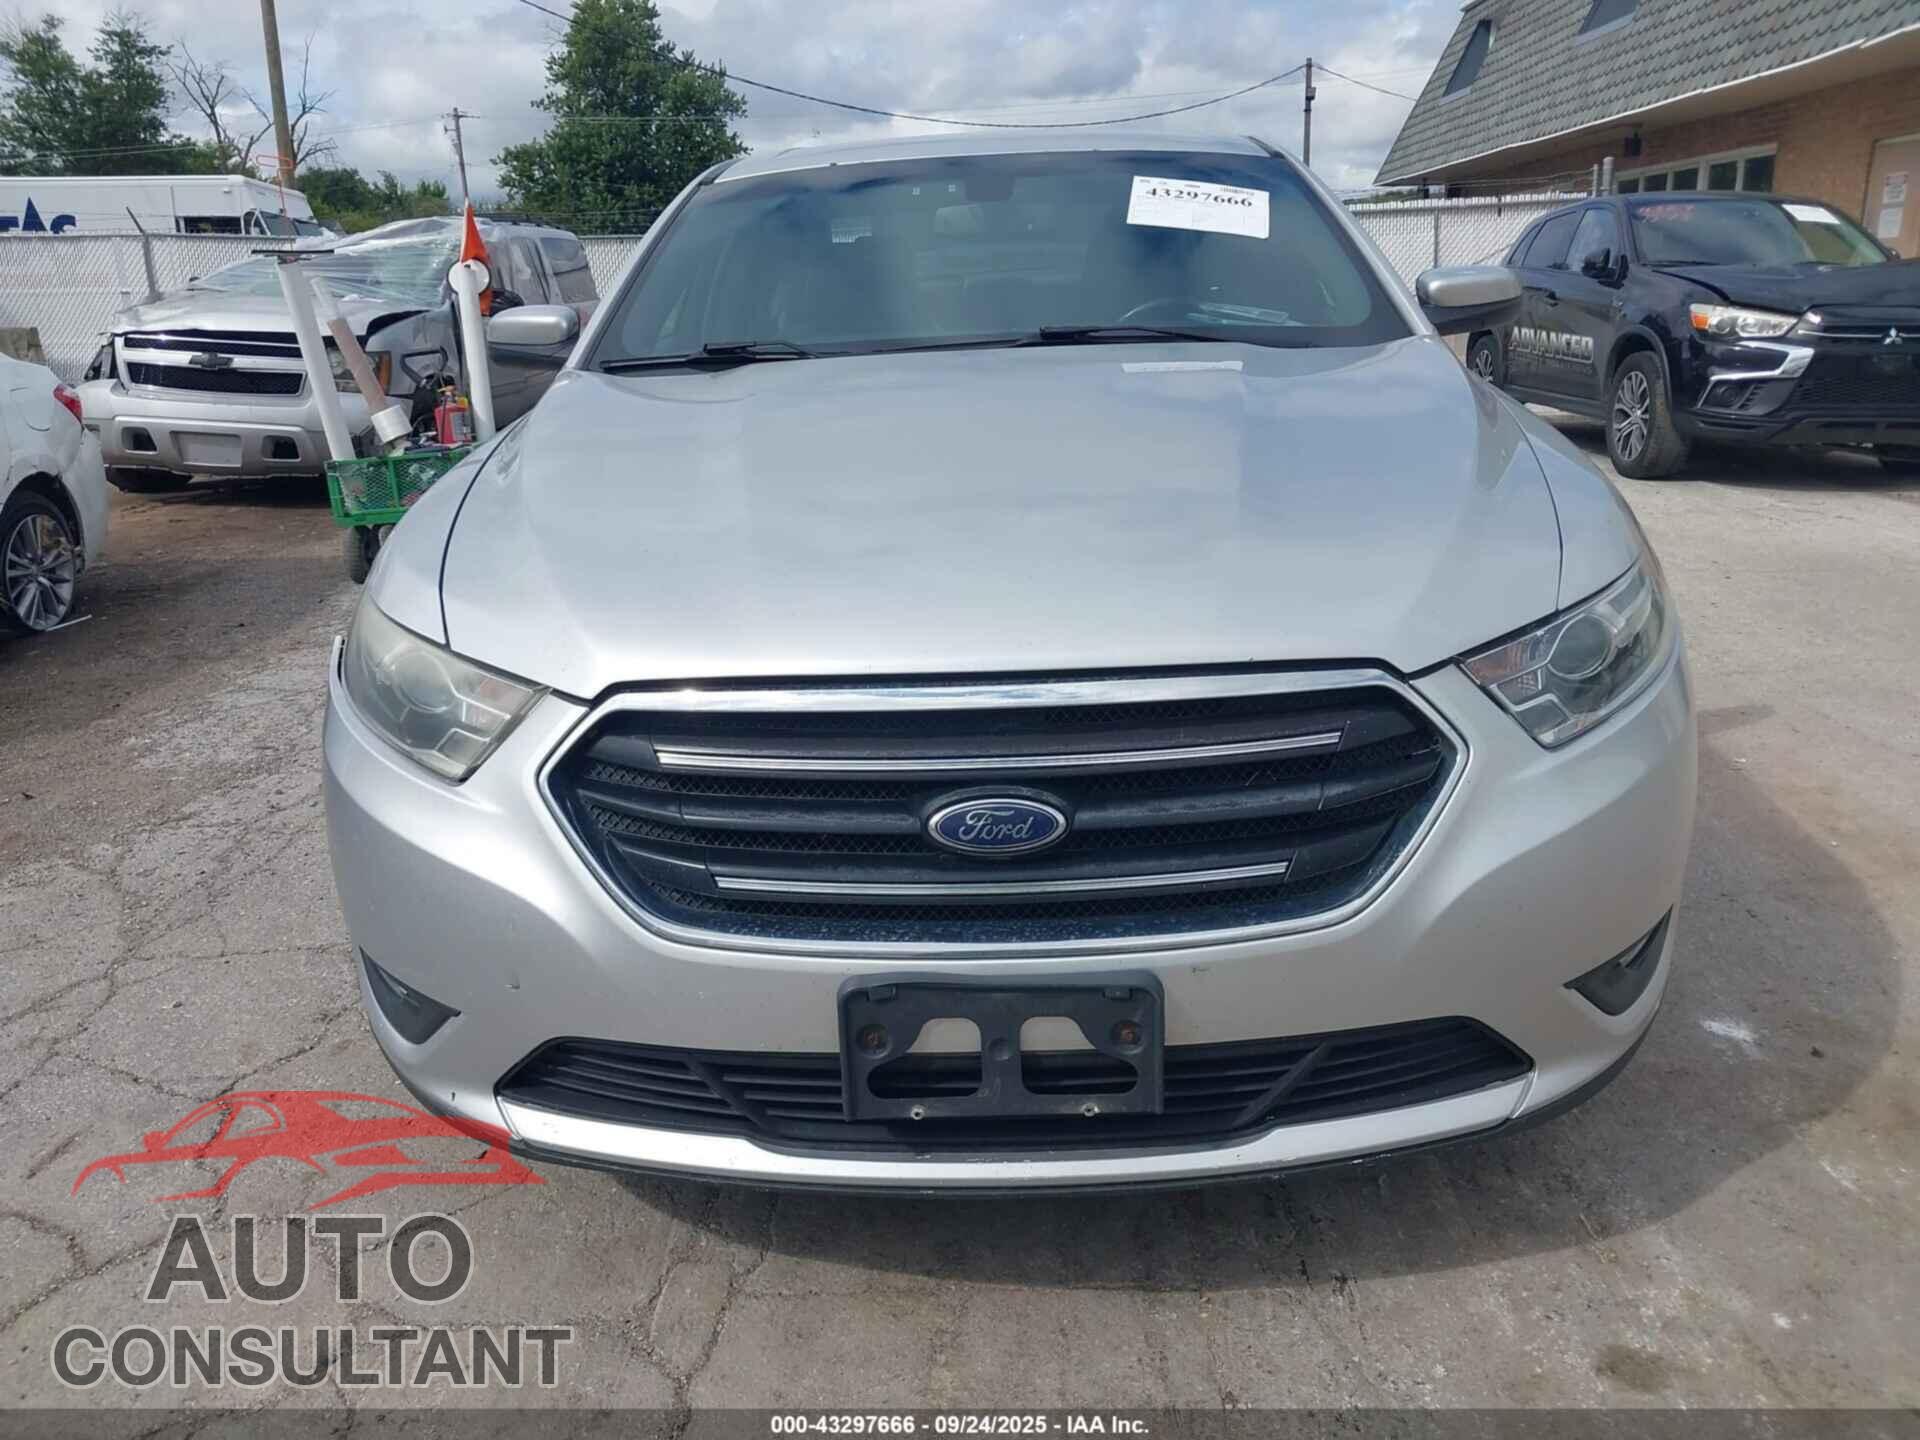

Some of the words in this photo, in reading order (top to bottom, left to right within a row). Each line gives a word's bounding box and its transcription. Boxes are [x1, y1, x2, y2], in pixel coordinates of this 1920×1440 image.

[1145, 186, 1253, 208] 43297666
[1507, 325, 1593, 363] ADVANCED
[958, 809, 1035, 841] Ford
